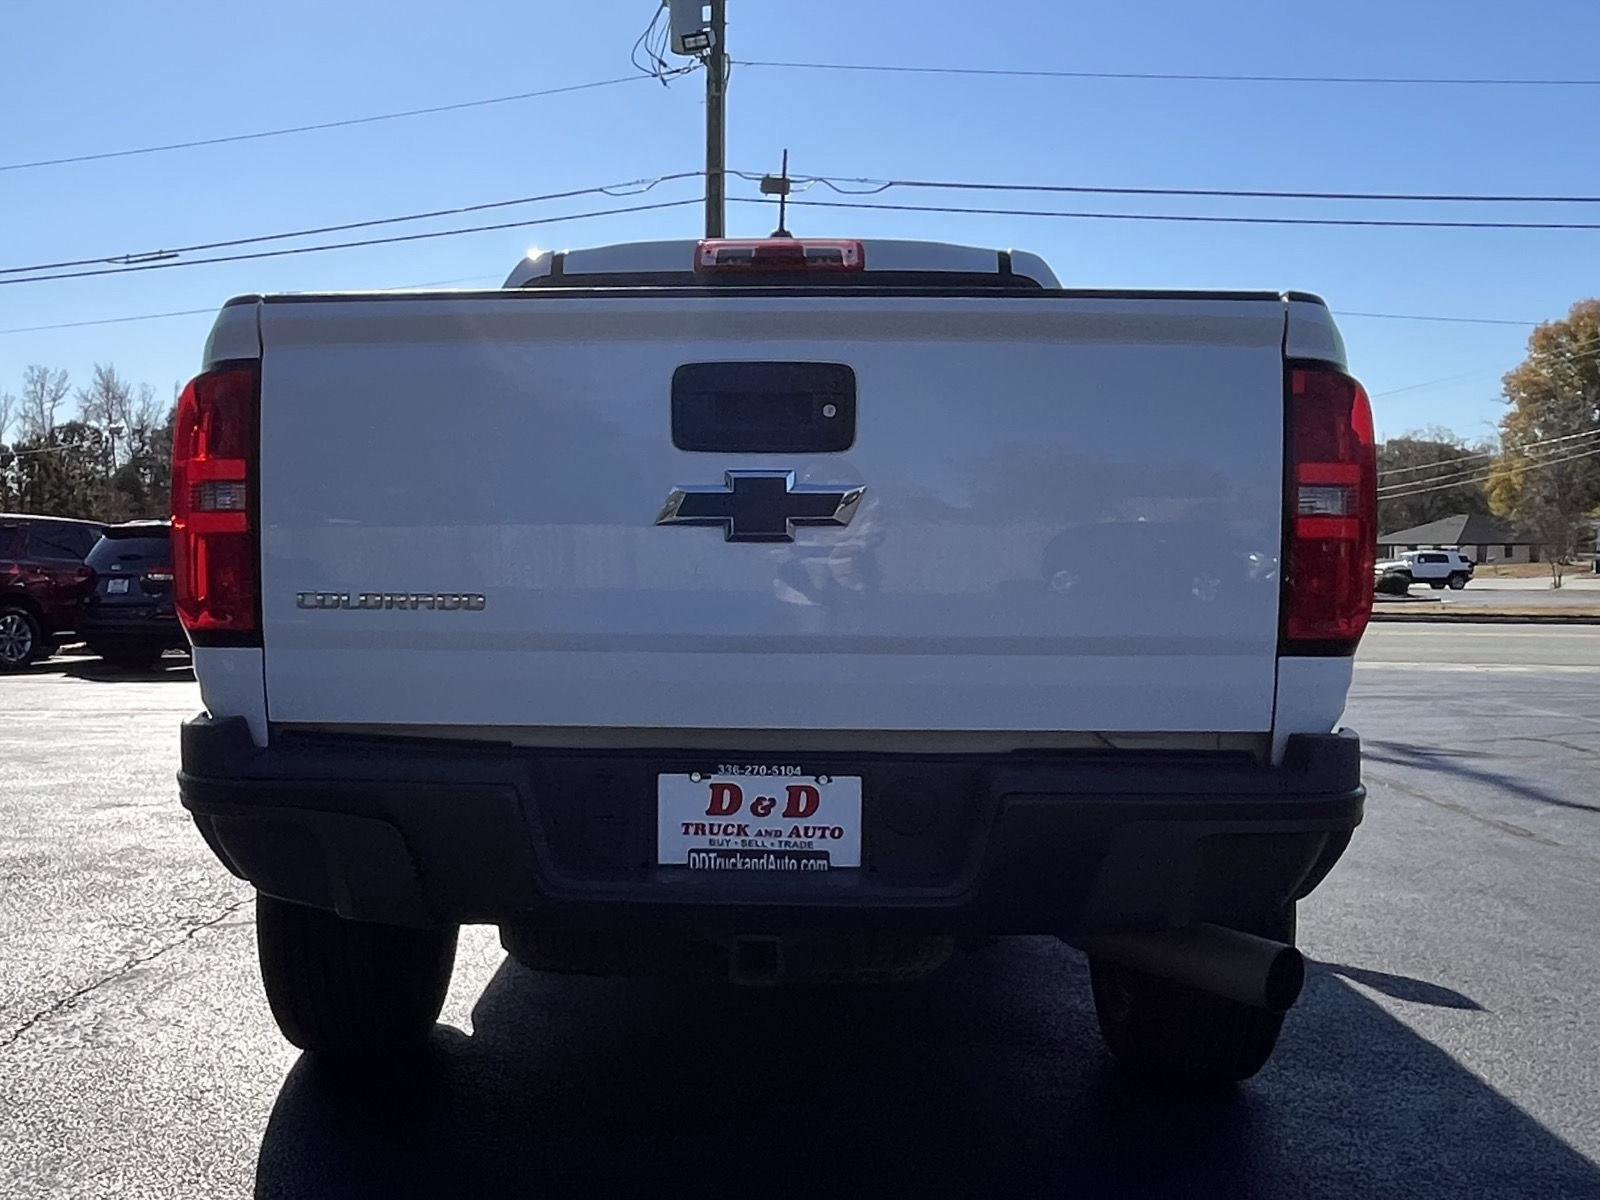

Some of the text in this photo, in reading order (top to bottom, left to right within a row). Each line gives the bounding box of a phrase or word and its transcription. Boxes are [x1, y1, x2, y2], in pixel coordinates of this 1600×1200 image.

[296, 592, 485, 611] COLORADO
[706, 783, 820, 818] D & D
[682, 823, 844, 839] TRUCK AND AUTO
[709, 839, 814, 849] BUY SELL TRADE
